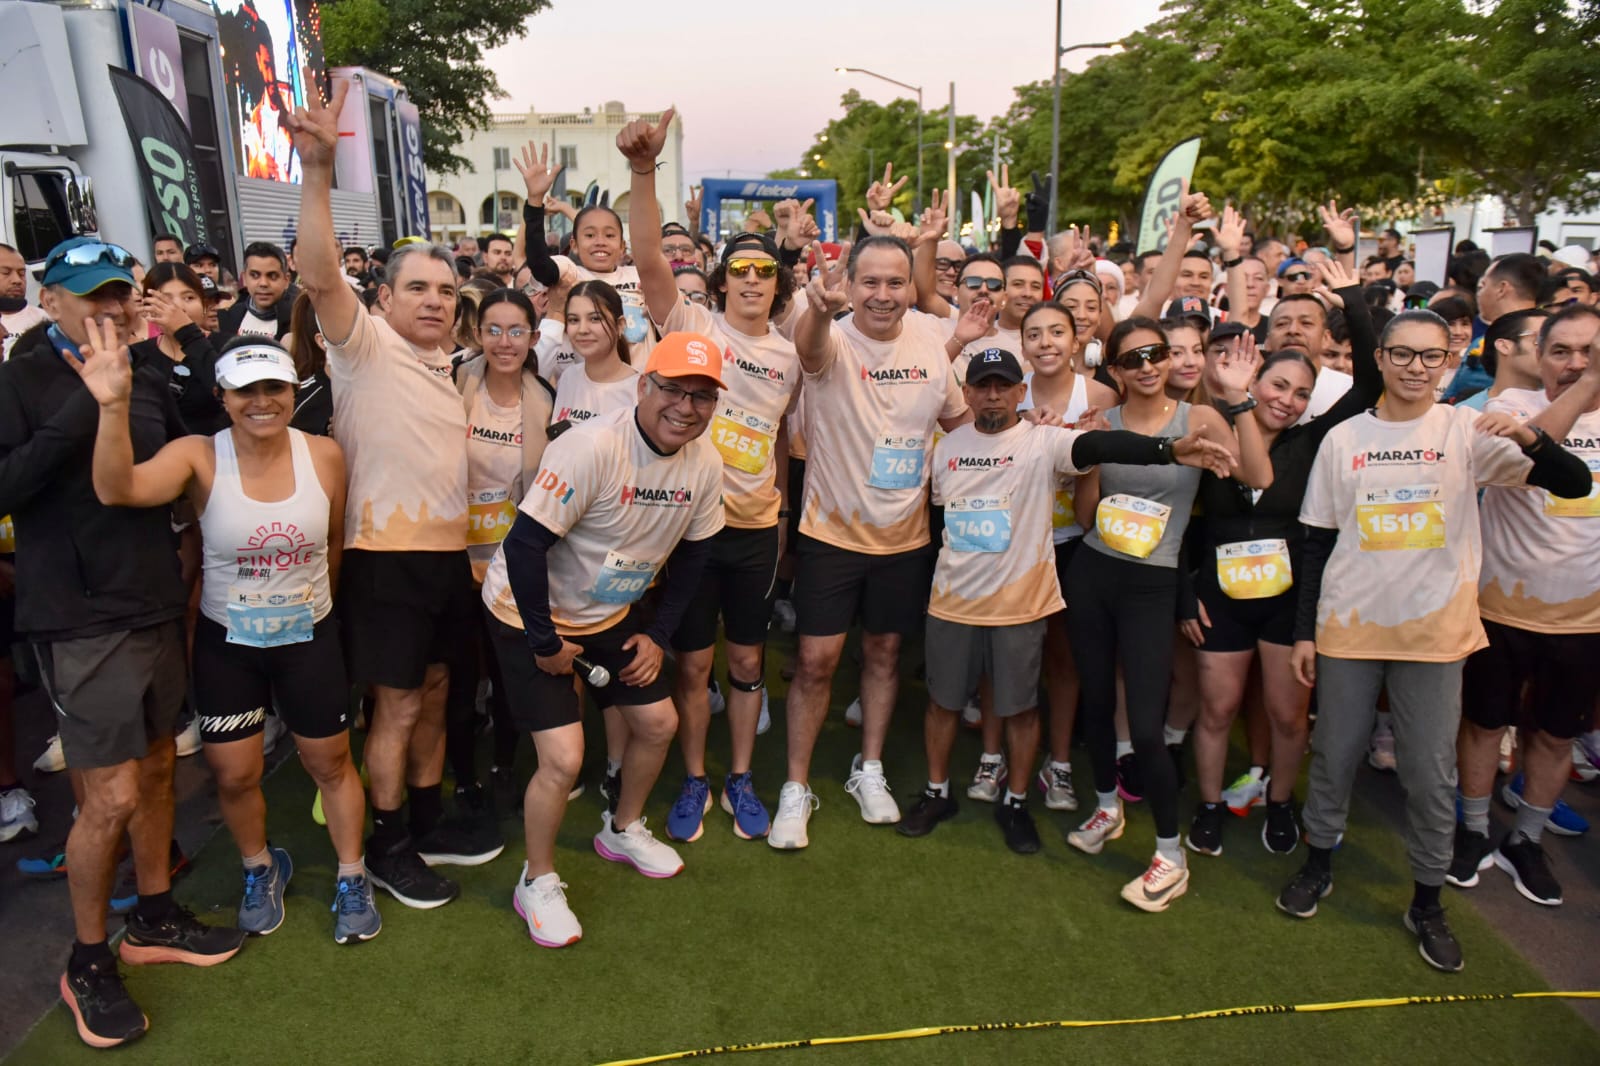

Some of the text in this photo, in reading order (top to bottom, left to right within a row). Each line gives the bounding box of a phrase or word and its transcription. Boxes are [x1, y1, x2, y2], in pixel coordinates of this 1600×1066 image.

[406, 123, 424, 183] 5G
[756, 184, 798, 197] telcel
[686, 340, 708, 366] S
[983, 348, 1002, 362] R
[868, 365, 928, 381] MARATÓN
[716, 428, 762, 457] 1253
[886, 458, 918, 475] 763
[535, 468, 575, 505] IDH
[634, 487, 692, 502] MARATÓN
[955, 520, 996, 537] 740
[1102, 517, 1153, 542] 1625
[1368, 512, 1428, 533] 1519
[237, 551, 313, 570] PINOLE
[1227, 563, 1277, 583] 1419
[605, 577, 645, 592] 780
[239, 615, 299, 635] 1137
